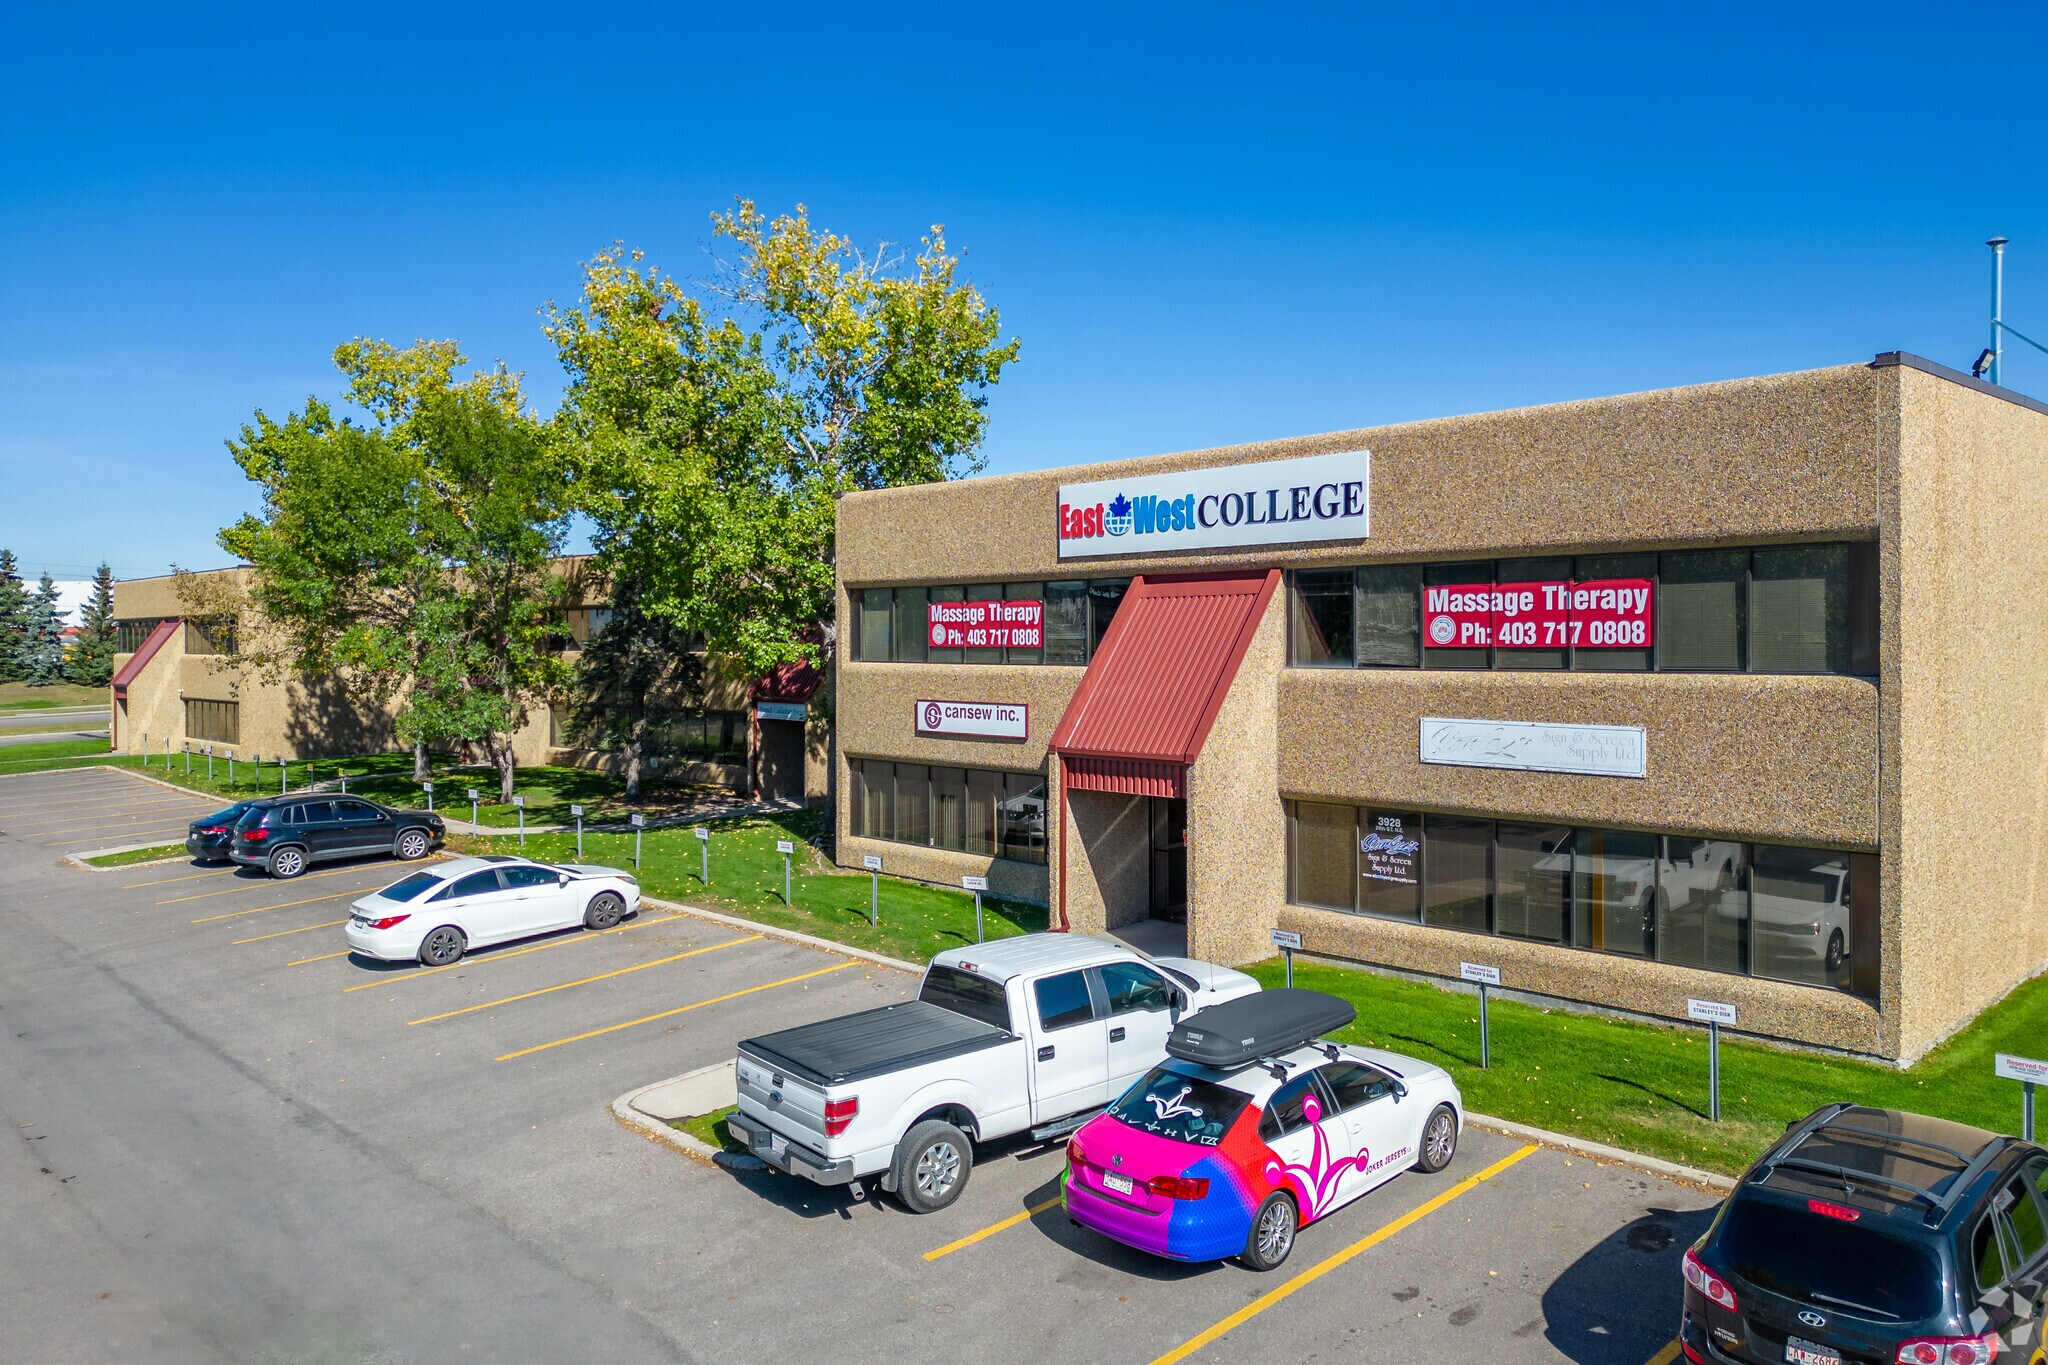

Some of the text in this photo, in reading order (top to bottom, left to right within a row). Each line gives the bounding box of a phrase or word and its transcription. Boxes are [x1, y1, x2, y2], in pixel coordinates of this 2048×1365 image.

[1060, 481, 1364, 540] East West COLLEGE
[1428, 585, 1649, 616] Massage Therapy
[931, 603, 1041, 625] Massage Therapy
[948, 629, 964, 645] Ph:
[967, 629, 987, 646] 403
[989, 629, 1009, 646] 717
[1012, 628, 1040, 646] 0808
[1461, 622, 1493, 645] Ph:
[1498, 622, 1537, 645] 403
[1543, 622, 1583, 645] 717
[1589, 621, 1645, 645] 0808
[944, 705, 1020, 722] cansew inc.
[1542, 730, 1567, 748] Sign
[1572, 730, 1584, 744] &
[1589, 732, 1635, 747] Screen
[1567, 744, 1640, 763] Supply Ltd.
[1378, 817, 1401, 828] 3928
[1367, 853, 1380, 863] Sign
[1389, 856, 1412, 865] Screen
[1371, 864, 1393, 874] Supply
[1693, 1007, 1718, 1015] STANLEY'S
[2006, 1059, 2037, 1069] Reserved
[1366, 1159, 1383, 1175] JOKER
